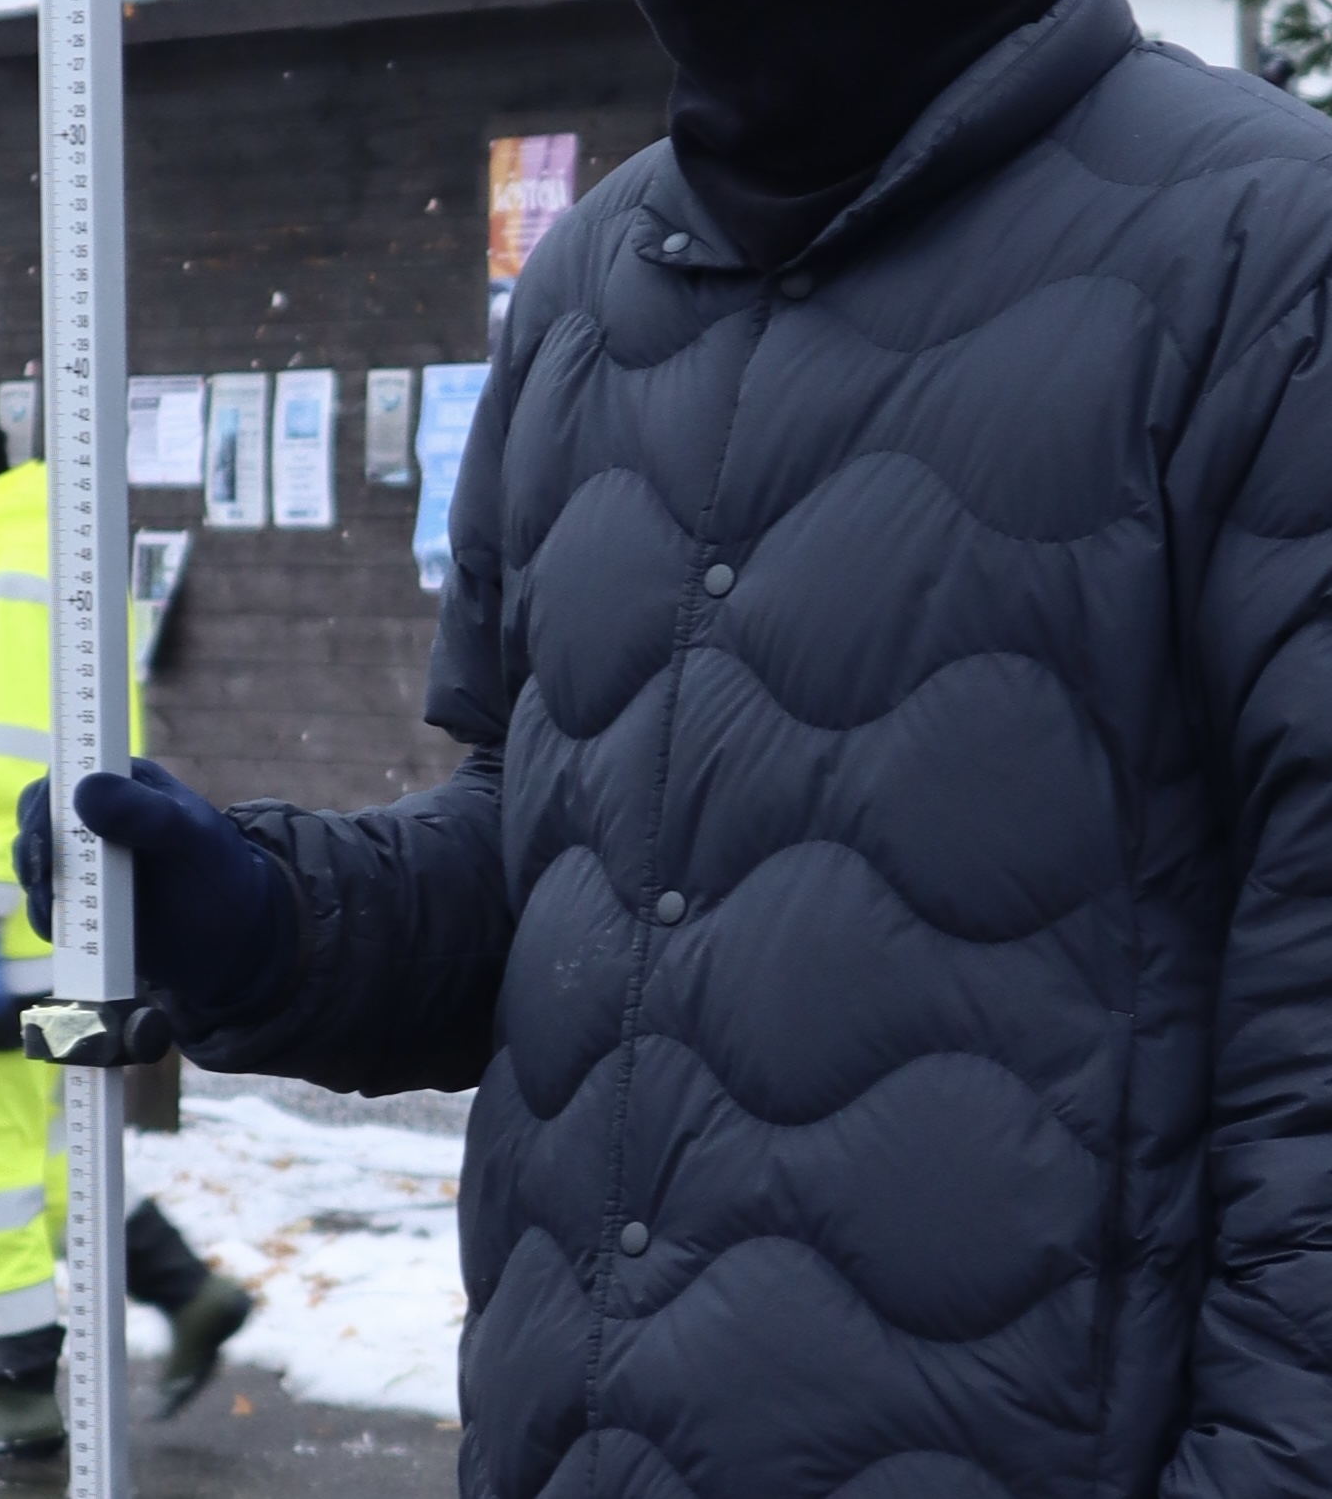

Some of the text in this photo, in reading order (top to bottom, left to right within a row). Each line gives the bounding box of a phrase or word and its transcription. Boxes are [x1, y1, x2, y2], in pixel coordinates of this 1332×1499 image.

[66, 10, 84, 24] +25
[67, 34, 85, 48] +26
[67, 58, 85, 70] +27
[67, 80, 85, 94] +28
[68, 104, 86, 118] +29
[62, 125, 86, 145] +30
[65, 358, 89, 378] +40
[68, 590, 92, 611] +50
